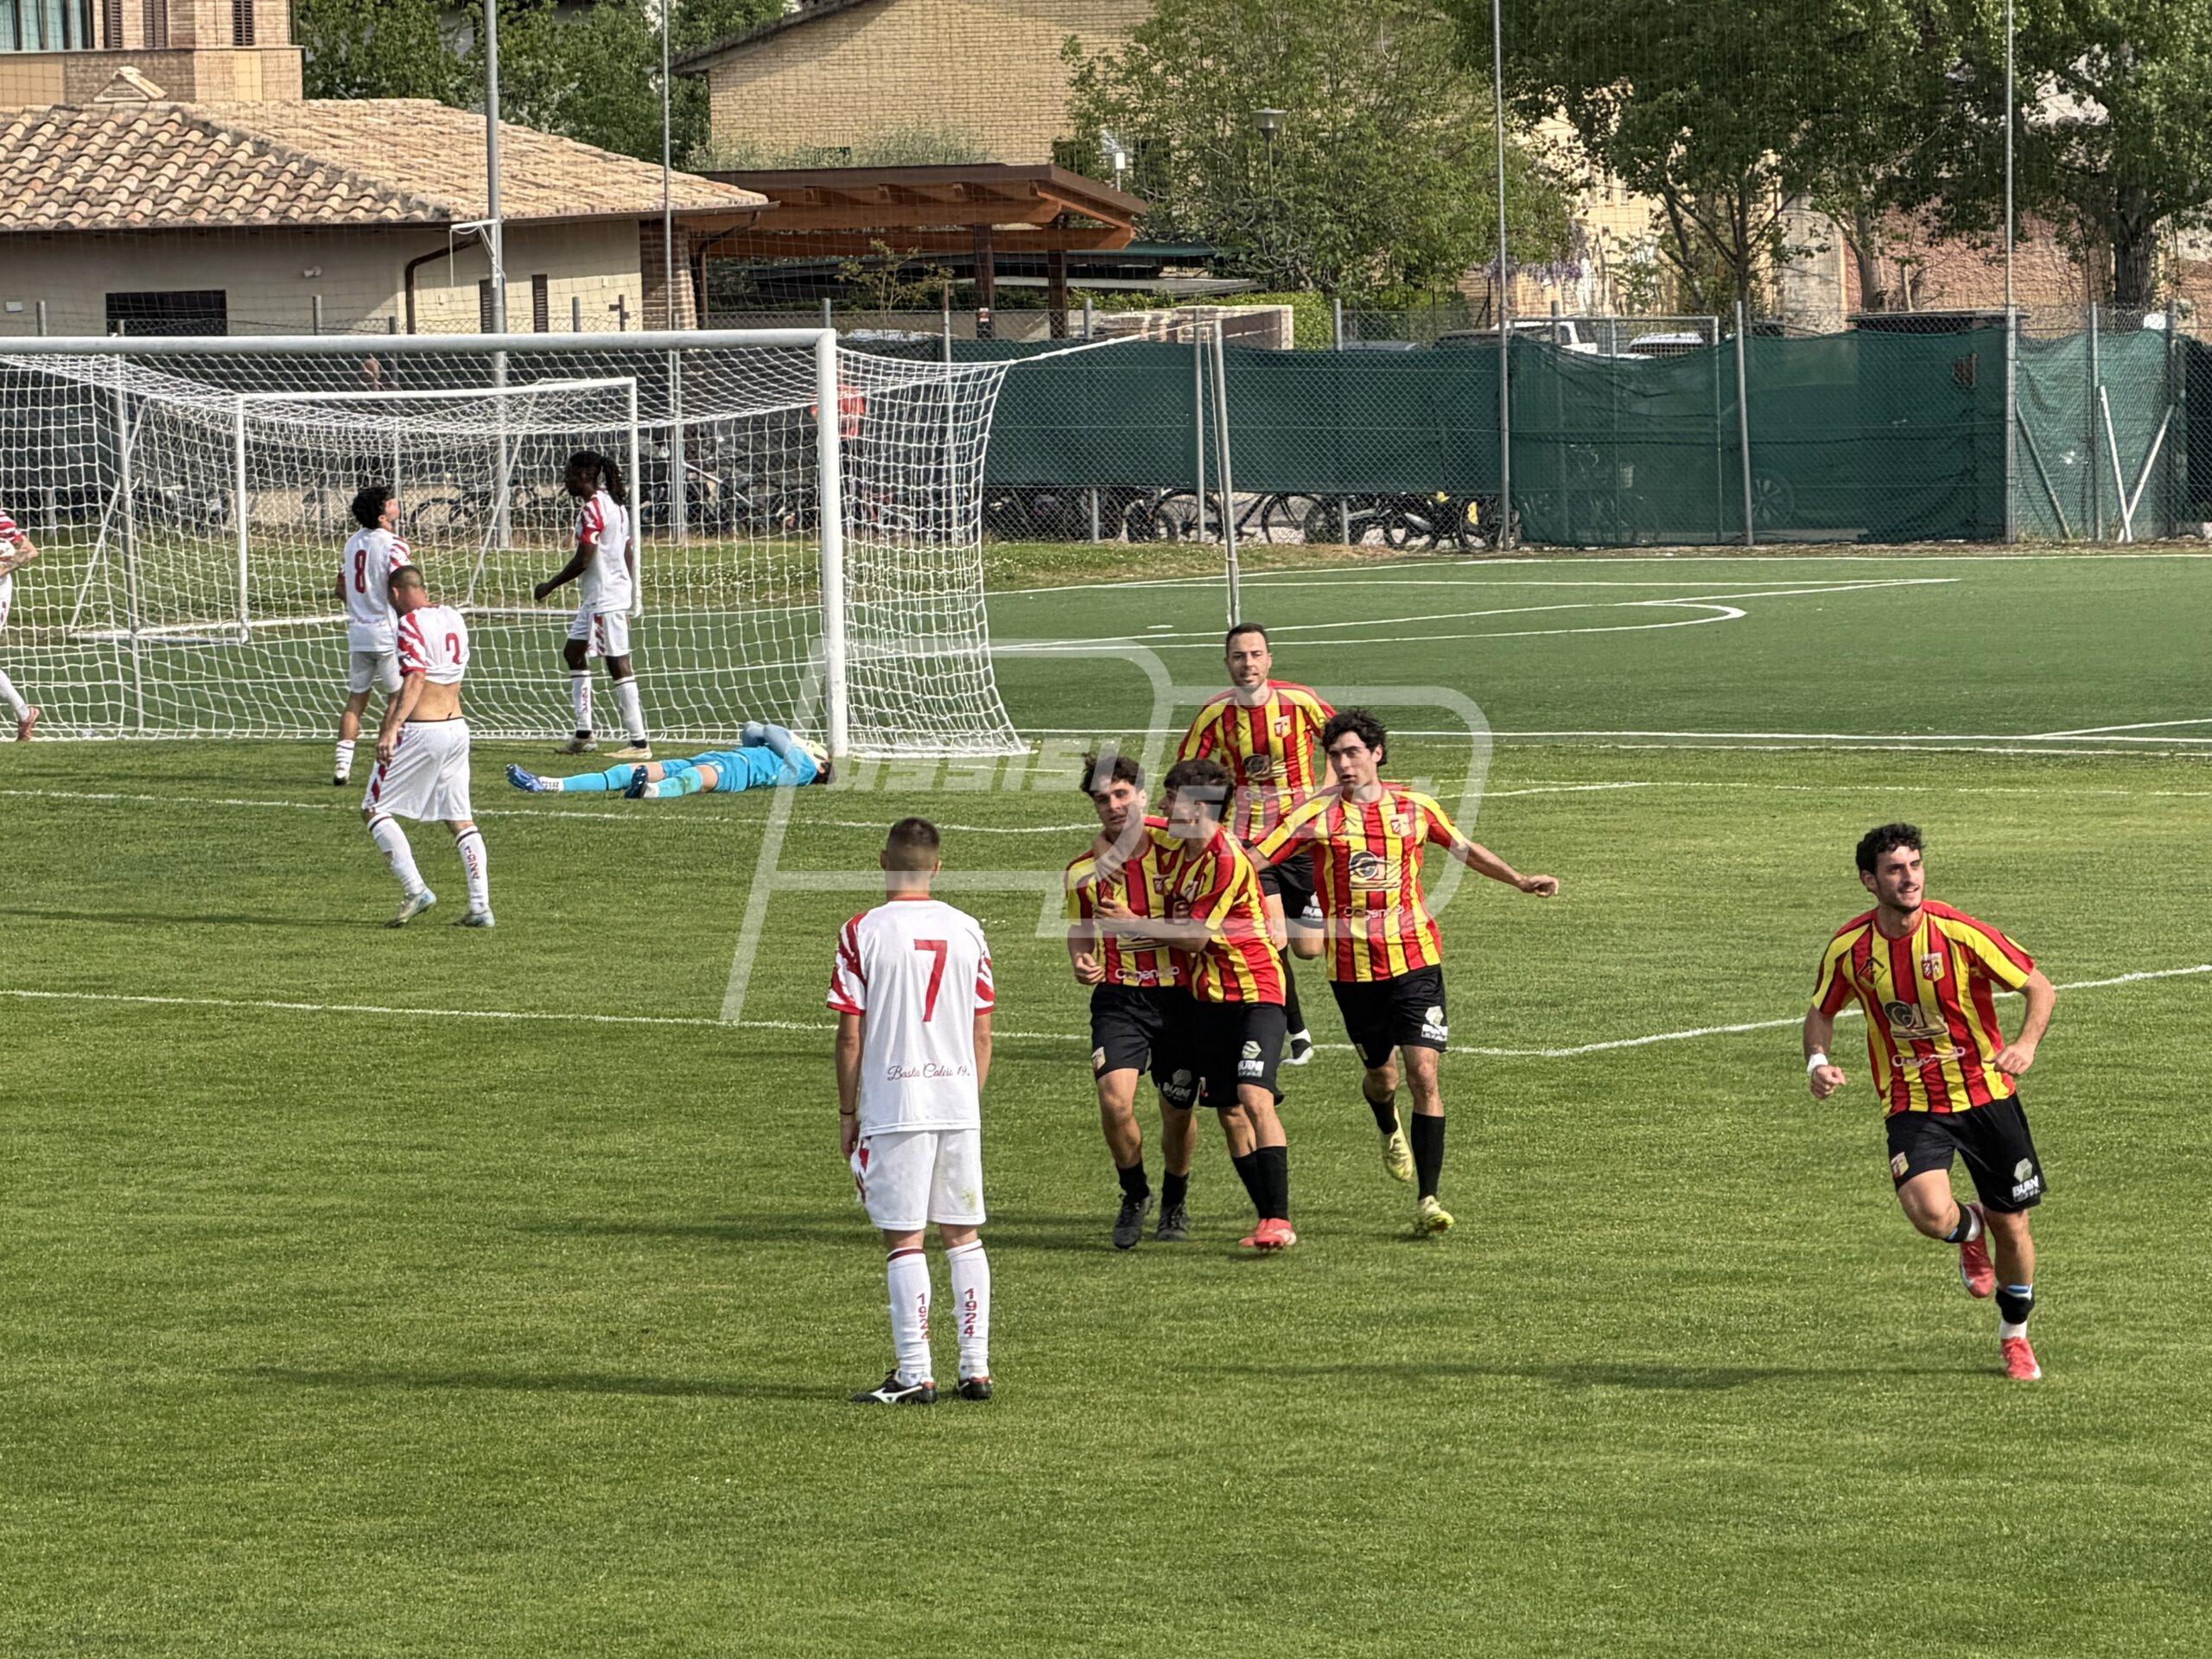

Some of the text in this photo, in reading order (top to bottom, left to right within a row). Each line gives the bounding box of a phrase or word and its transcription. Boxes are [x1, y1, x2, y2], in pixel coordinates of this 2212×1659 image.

[354, 549, 367, 594] 8
[445, 632, 461, 665] 2
[913, 938, 948, 1022] 7
[963, 1287, 978, 1338] 1924
